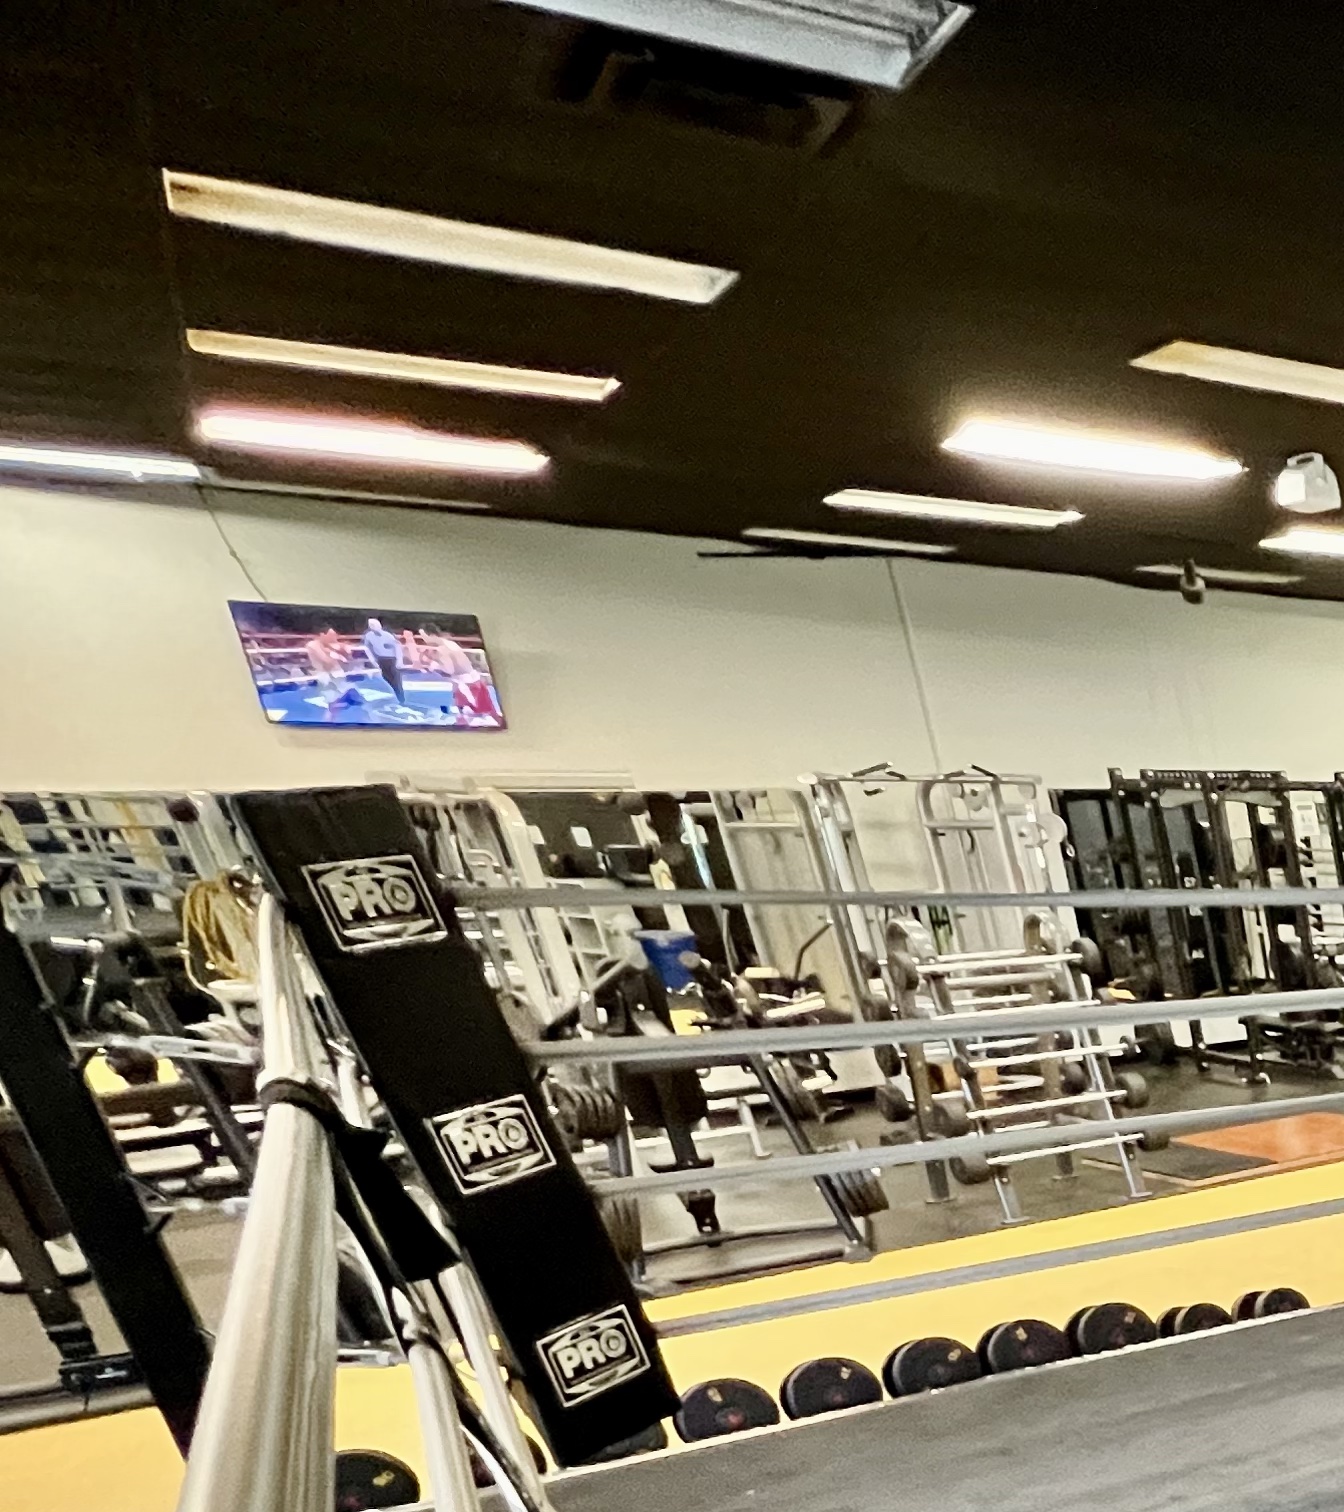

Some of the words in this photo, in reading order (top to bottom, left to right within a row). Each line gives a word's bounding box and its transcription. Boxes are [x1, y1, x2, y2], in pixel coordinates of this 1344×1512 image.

[330, 876, 416, 921] PRO
[450, 1118, 530, 1165] PRO
[556, 1328, 628, 1379] PRO
